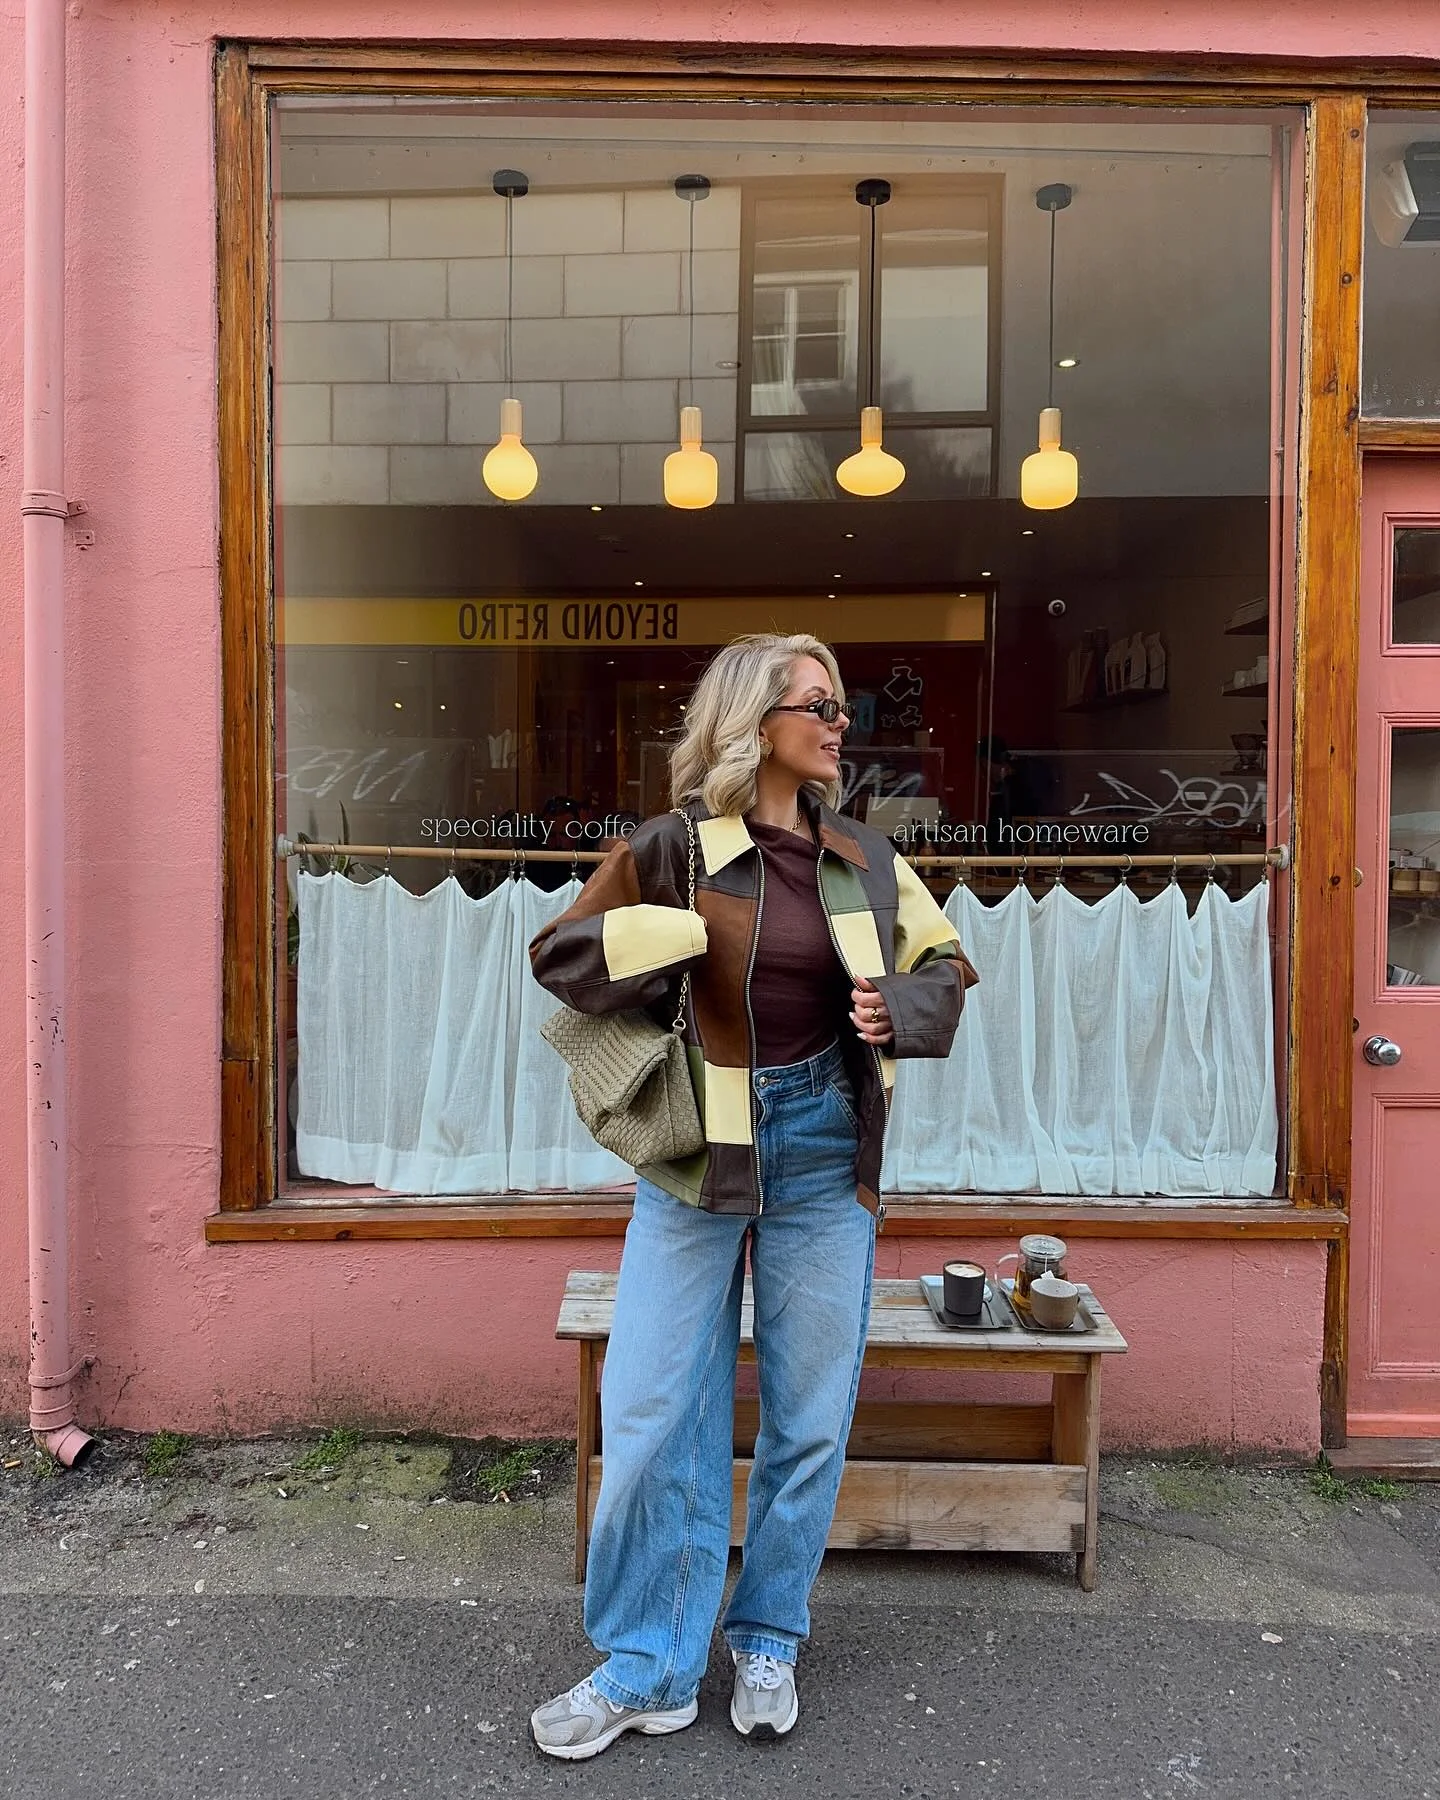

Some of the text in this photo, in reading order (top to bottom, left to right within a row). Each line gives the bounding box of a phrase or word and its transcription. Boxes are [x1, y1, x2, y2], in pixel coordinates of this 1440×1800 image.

[419, 812, 637, 845] speciality coffe
[893, 817, 1150, 843] artisan homeware
